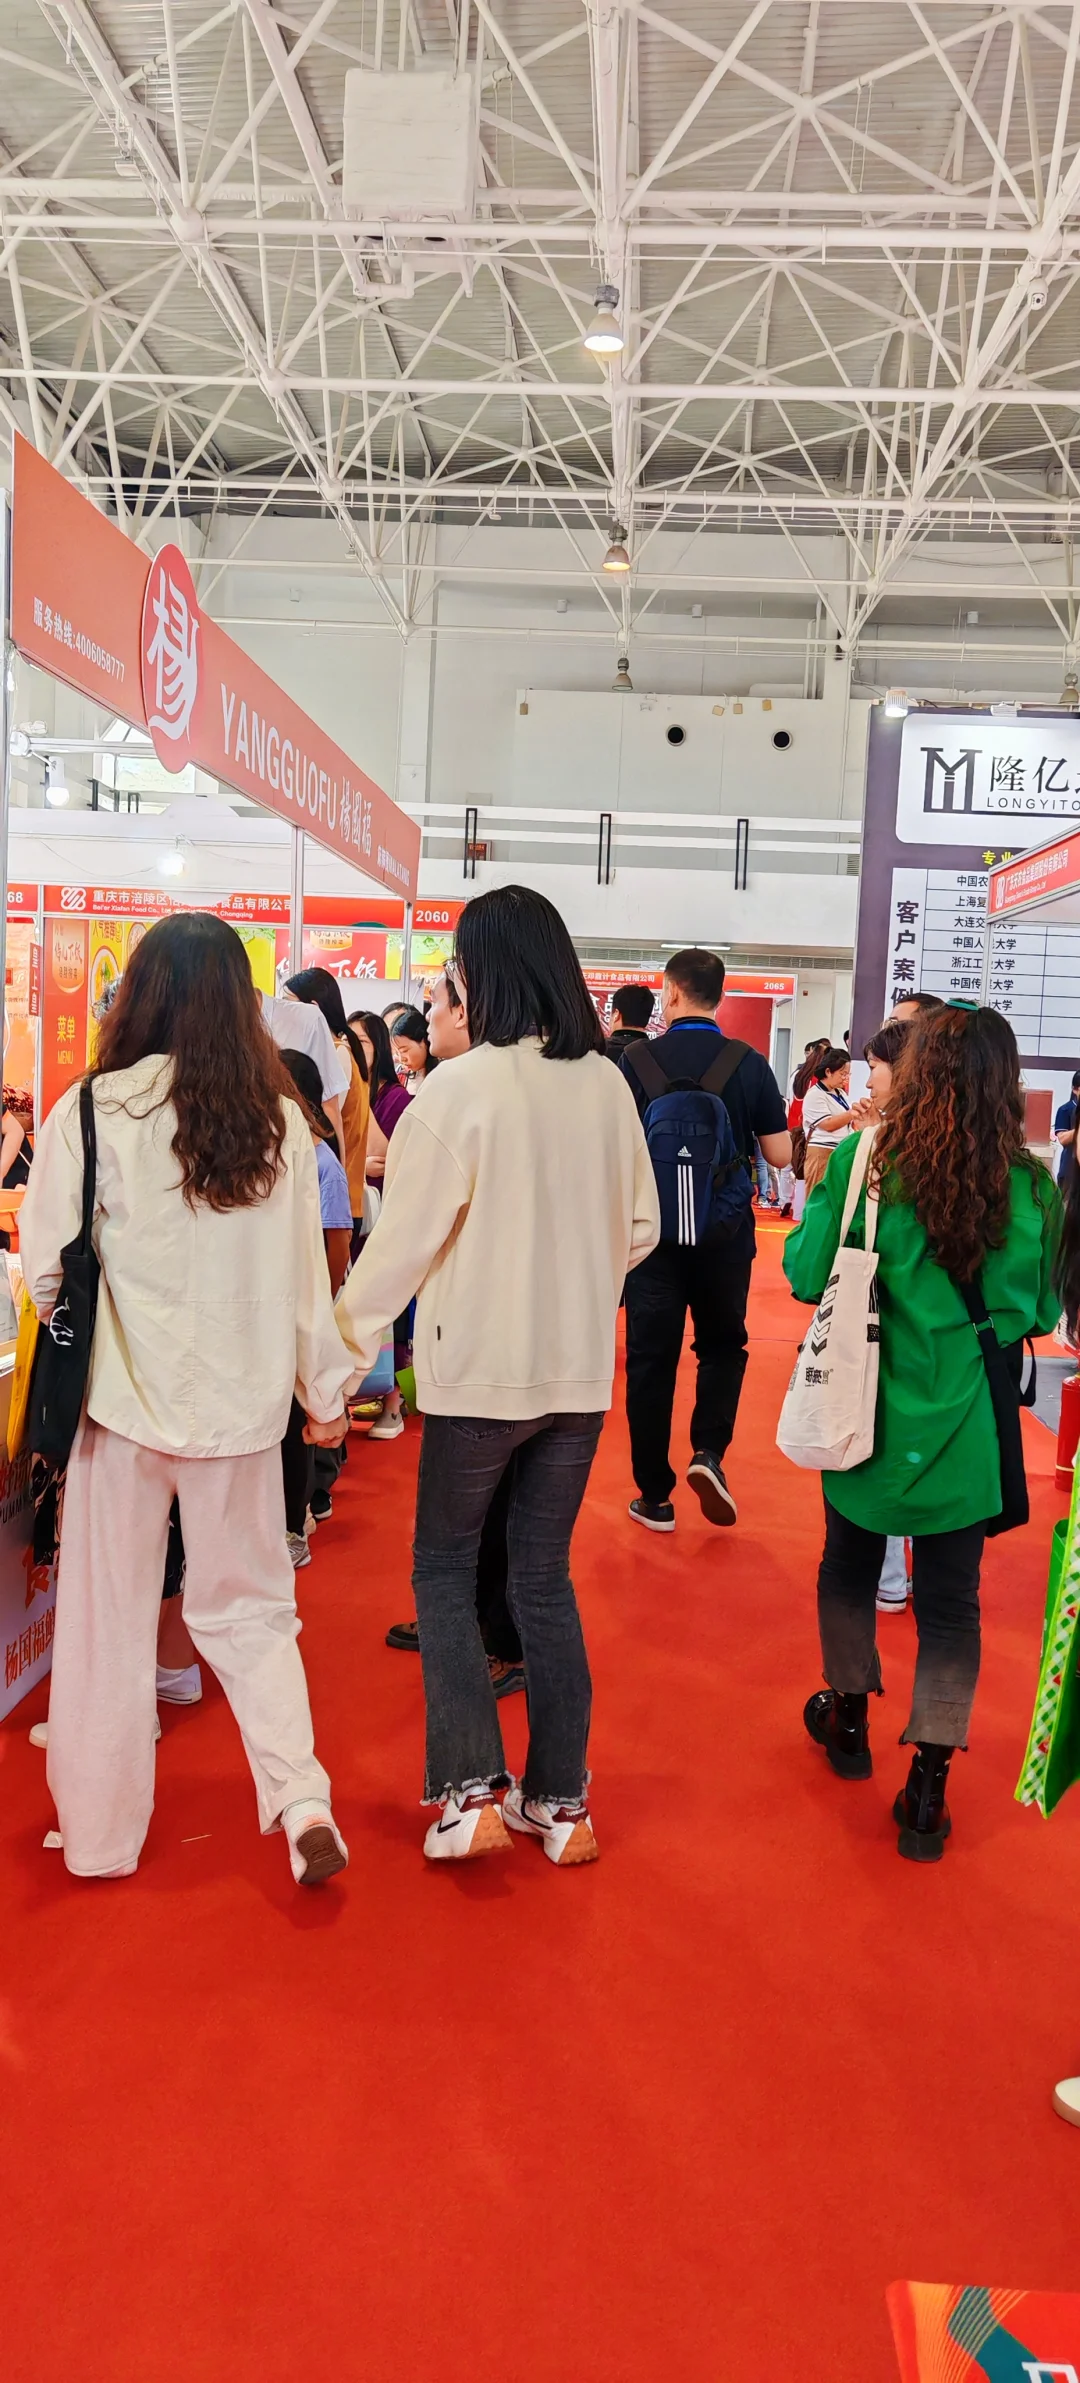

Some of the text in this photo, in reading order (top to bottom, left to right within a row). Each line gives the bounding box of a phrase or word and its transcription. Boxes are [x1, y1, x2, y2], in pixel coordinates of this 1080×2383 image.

[34, 597, 125, 683] 服务热线:4006058777
[220, 682, 337, 831] YANGGUOFU
[416, 910, 449, 923] 2060
[952, 936, 1017, 951] 中国人大学
[951, 956, 1016, 969] 浙江工大学
[764, 982, 785, 990] 2065
[57, 1015, 76, 1043] 菜单
[57, 1050, 74, 1065] MENU
